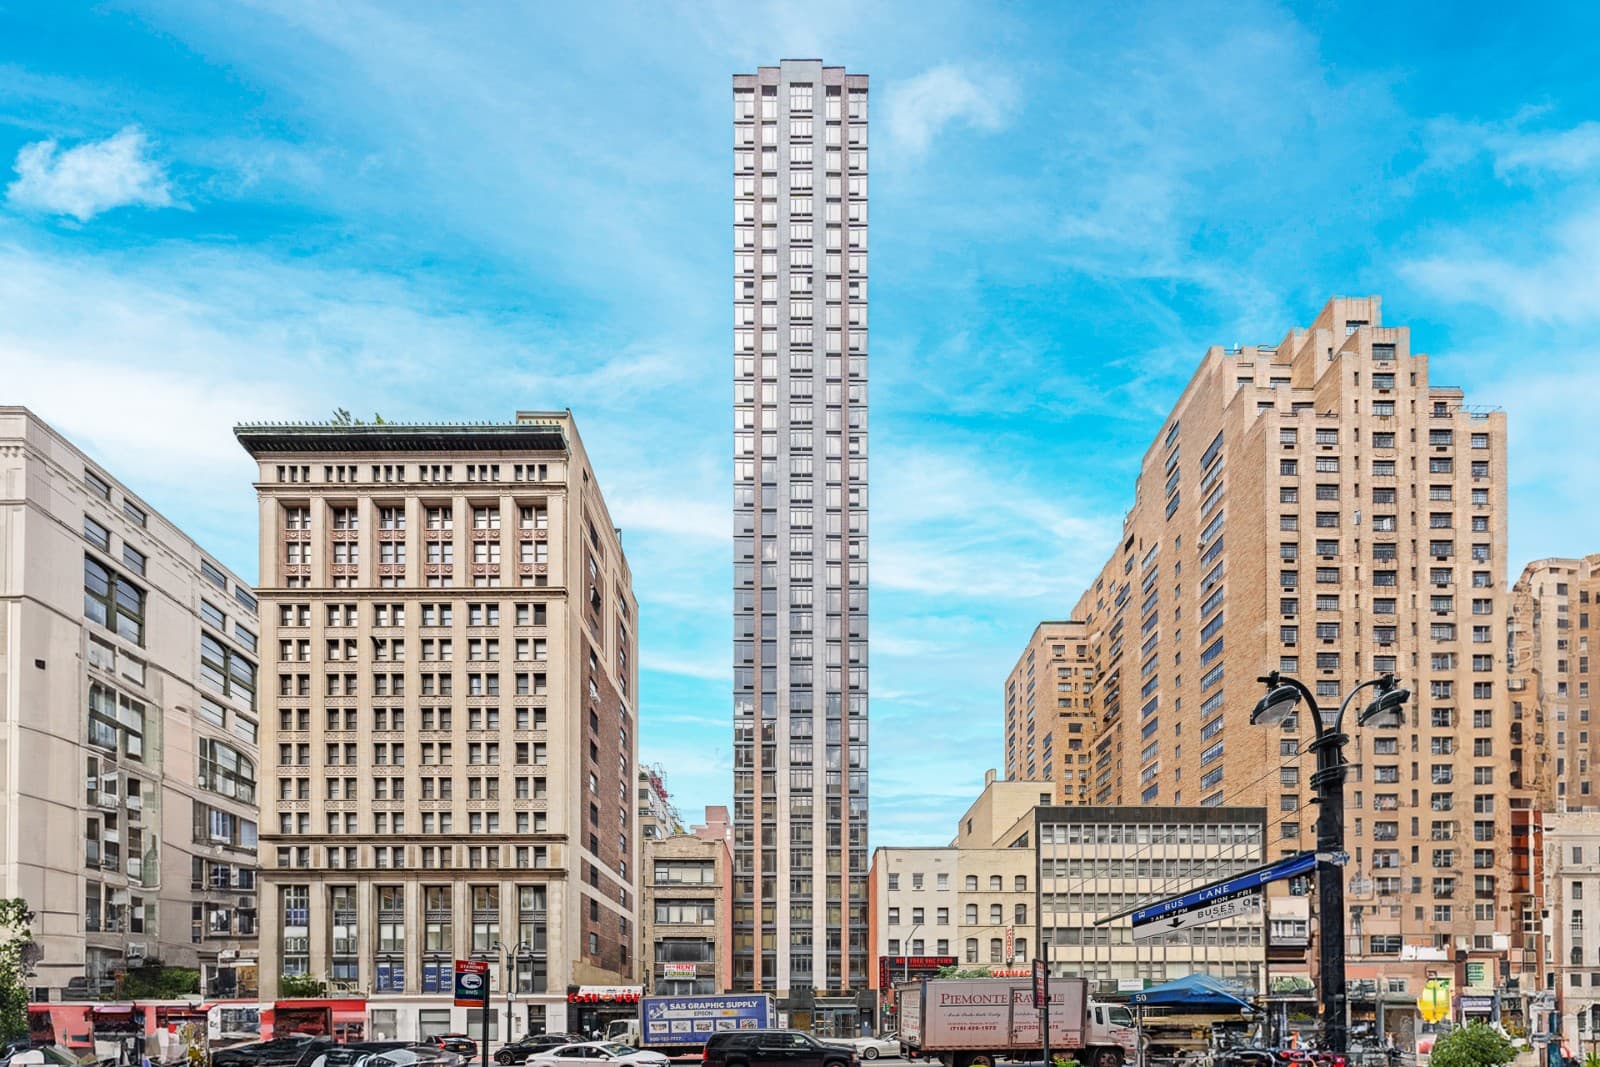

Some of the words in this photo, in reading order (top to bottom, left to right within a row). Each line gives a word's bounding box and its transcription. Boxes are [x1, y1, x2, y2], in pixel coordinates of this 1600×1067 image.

[1164, 899, 1184, 911] BUS
[1199, 884, 1230, 900] LANE
[1210, 895, 1228, 906] MON
[1237, 888, 1252, 898] FRI
[1197, 902, 1235, 919] BUSES
[940, 993, 1008, 1004] PIEMONTE
[1135, 993, 1147, 1002] 50
[670, 1002, 687, 1010] SAS
[726, 1001, 758, 1009] SUPPLY
